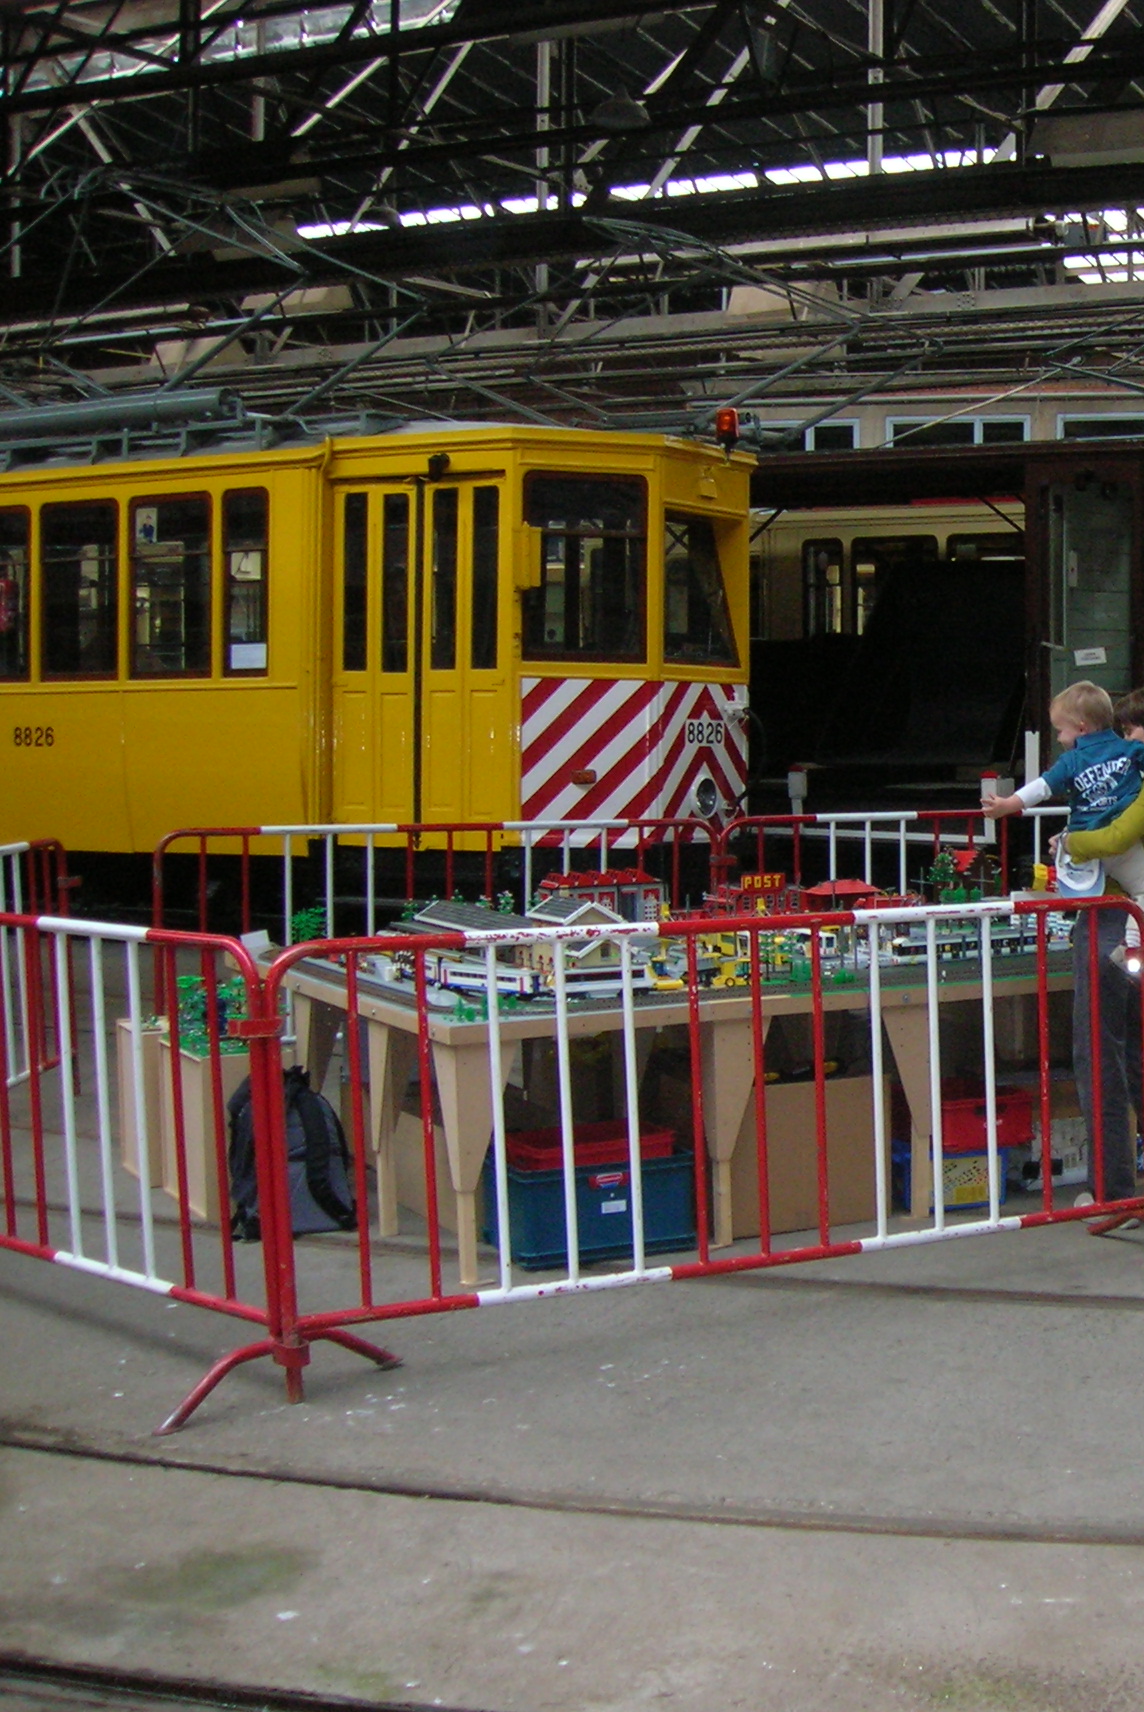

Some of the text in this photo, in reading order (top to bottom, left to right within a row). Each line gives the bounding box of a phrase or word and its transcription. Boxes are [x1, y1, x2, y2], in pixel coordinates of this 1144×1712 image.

[14, 726, 54, 747] 8826
[687, 722, 723, 744] 8826
[1073, 757, 1131, 792] DEFENDER
[744, 875, 781, 889] POST
